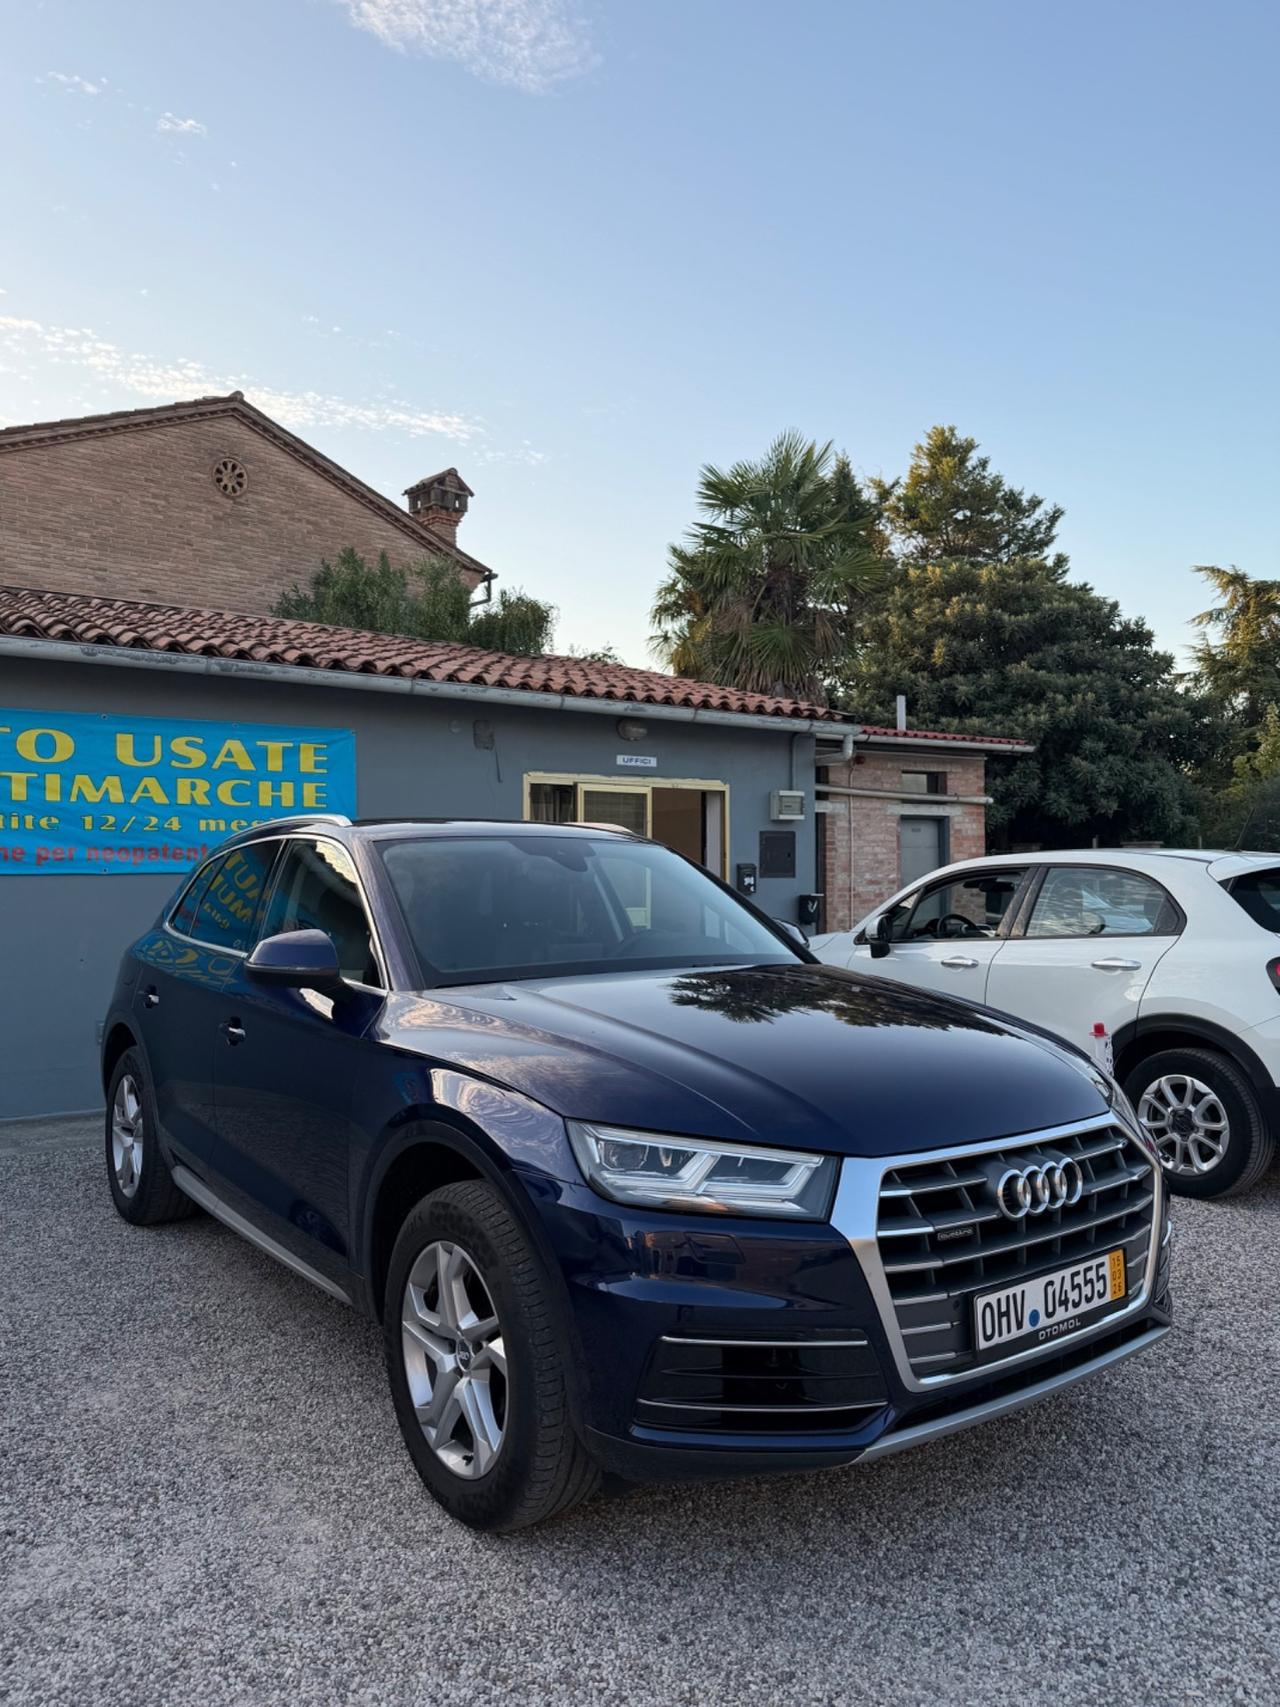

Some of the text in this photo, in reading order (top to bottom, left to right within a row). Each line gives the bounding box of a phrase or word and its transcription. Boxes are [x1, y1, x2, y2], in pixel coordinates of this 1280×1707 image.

[0, 726, 328, 774] O USATE
[0, 771, 328, 808] TIMARCHE
[81, 815, 182, 832] 12/24
[36, 847, 78, 867] per
[981, 1261, 1108, 1343] OHV 04555
